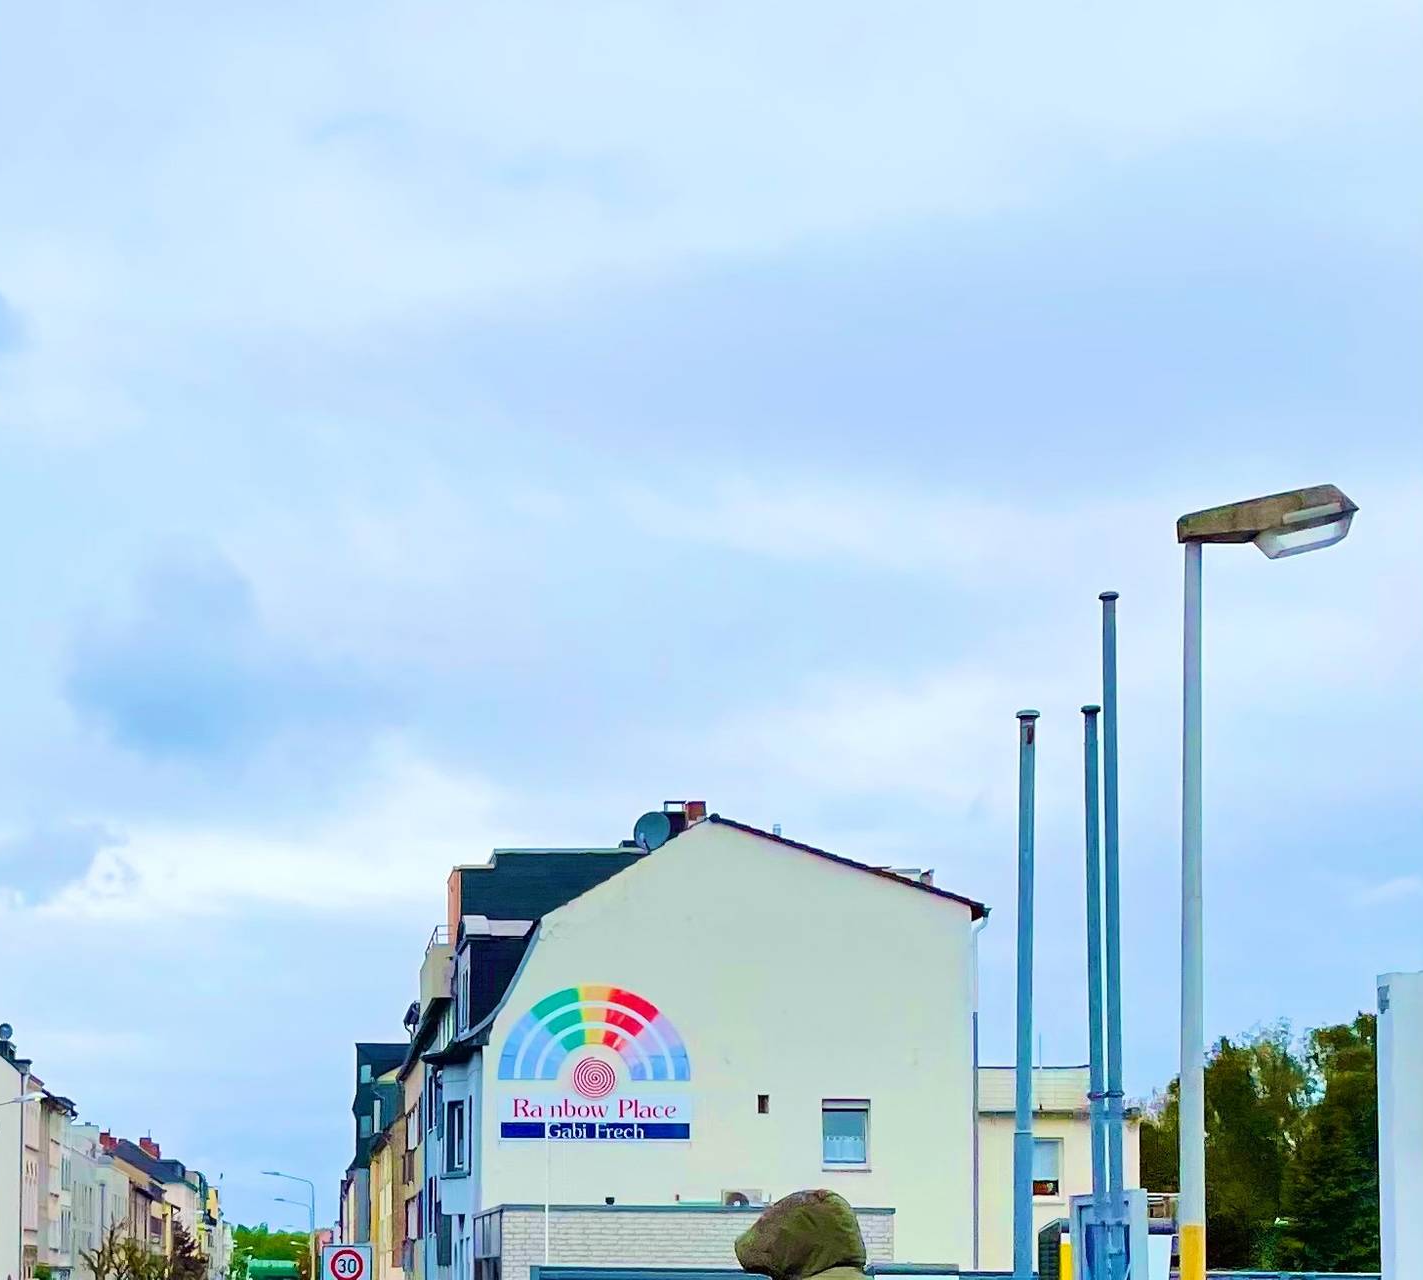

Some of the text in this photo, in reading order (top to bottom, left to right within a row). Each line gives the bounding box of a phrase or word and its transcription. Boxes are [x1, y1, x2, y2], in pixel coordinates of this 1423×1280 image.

[514, 1098, 676, 1119] Ranbow Place
[548, 1123, 644, 1139] Gabi Frech
[337, 1258, 357, 1274] 30
